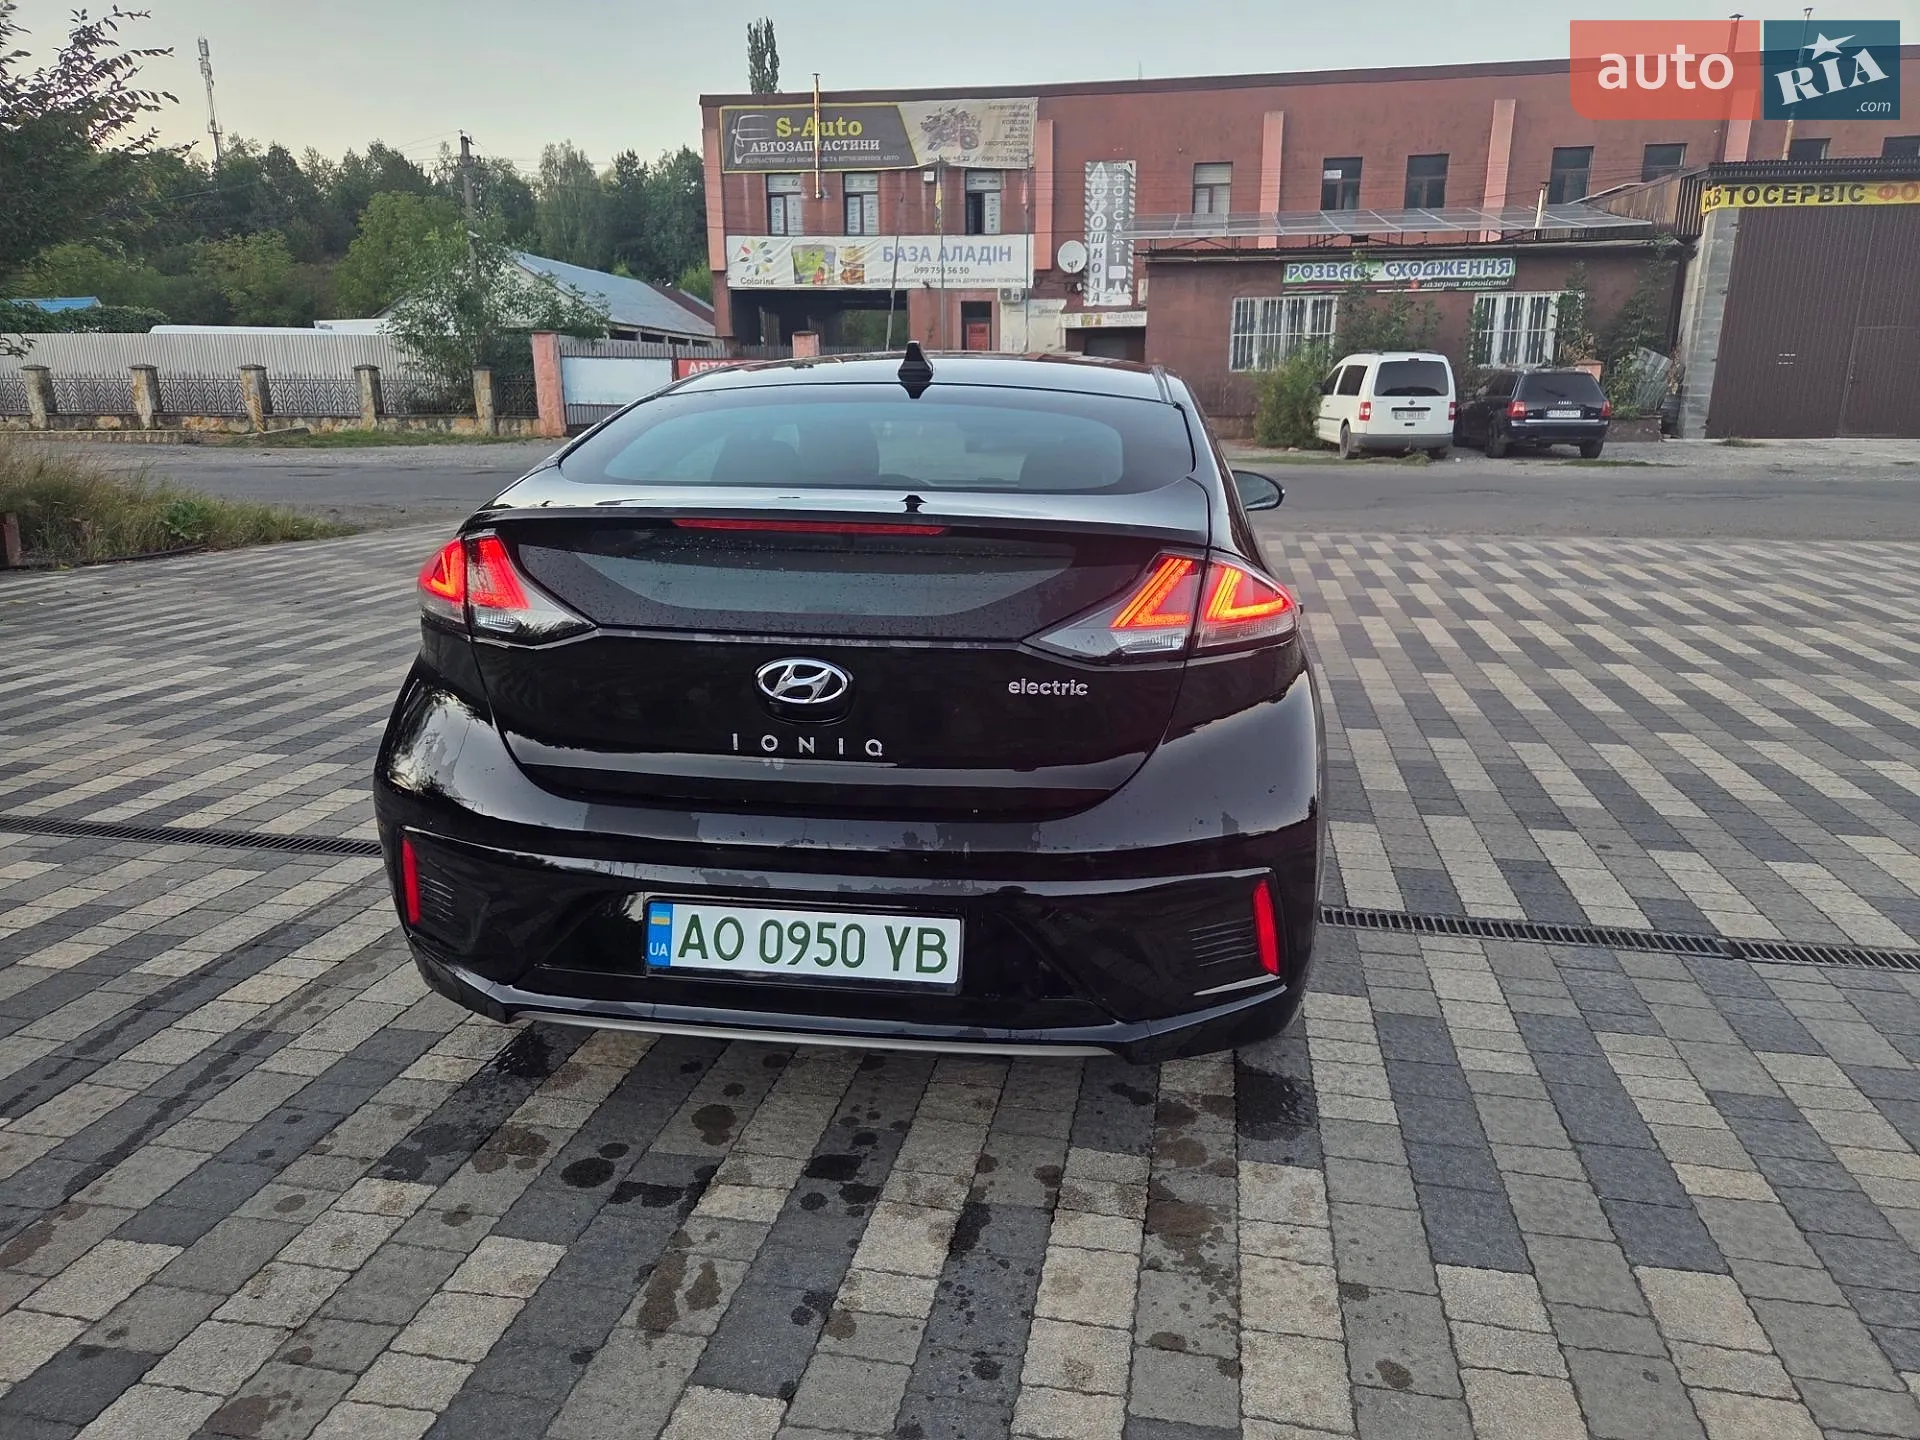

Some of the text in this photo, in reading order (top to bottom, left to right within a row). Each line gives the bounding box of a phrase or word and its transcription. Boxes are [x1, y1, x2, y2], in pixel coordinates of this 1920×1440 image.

[776, 116, 863, 138] S-Auto
[750, 139, 880, 153] АВТОЗАПАСТИНИ
[1704, 183, 1865, 210] АВТОСЕРВІС
[883, 246, 1012, 265] БАЗА АЛАДІН
[1286, 263, 1367, 281] РОЗВАЛ
[1385, 258, 1513, 278] СХОДЖЕННЯ
[1008, 678, 1089, 697] electric
[731, 732, 884, 758] IONIQ
[649, 942, 668, 957] UA
[677, 913, 948, 974] AO 0950 YB
